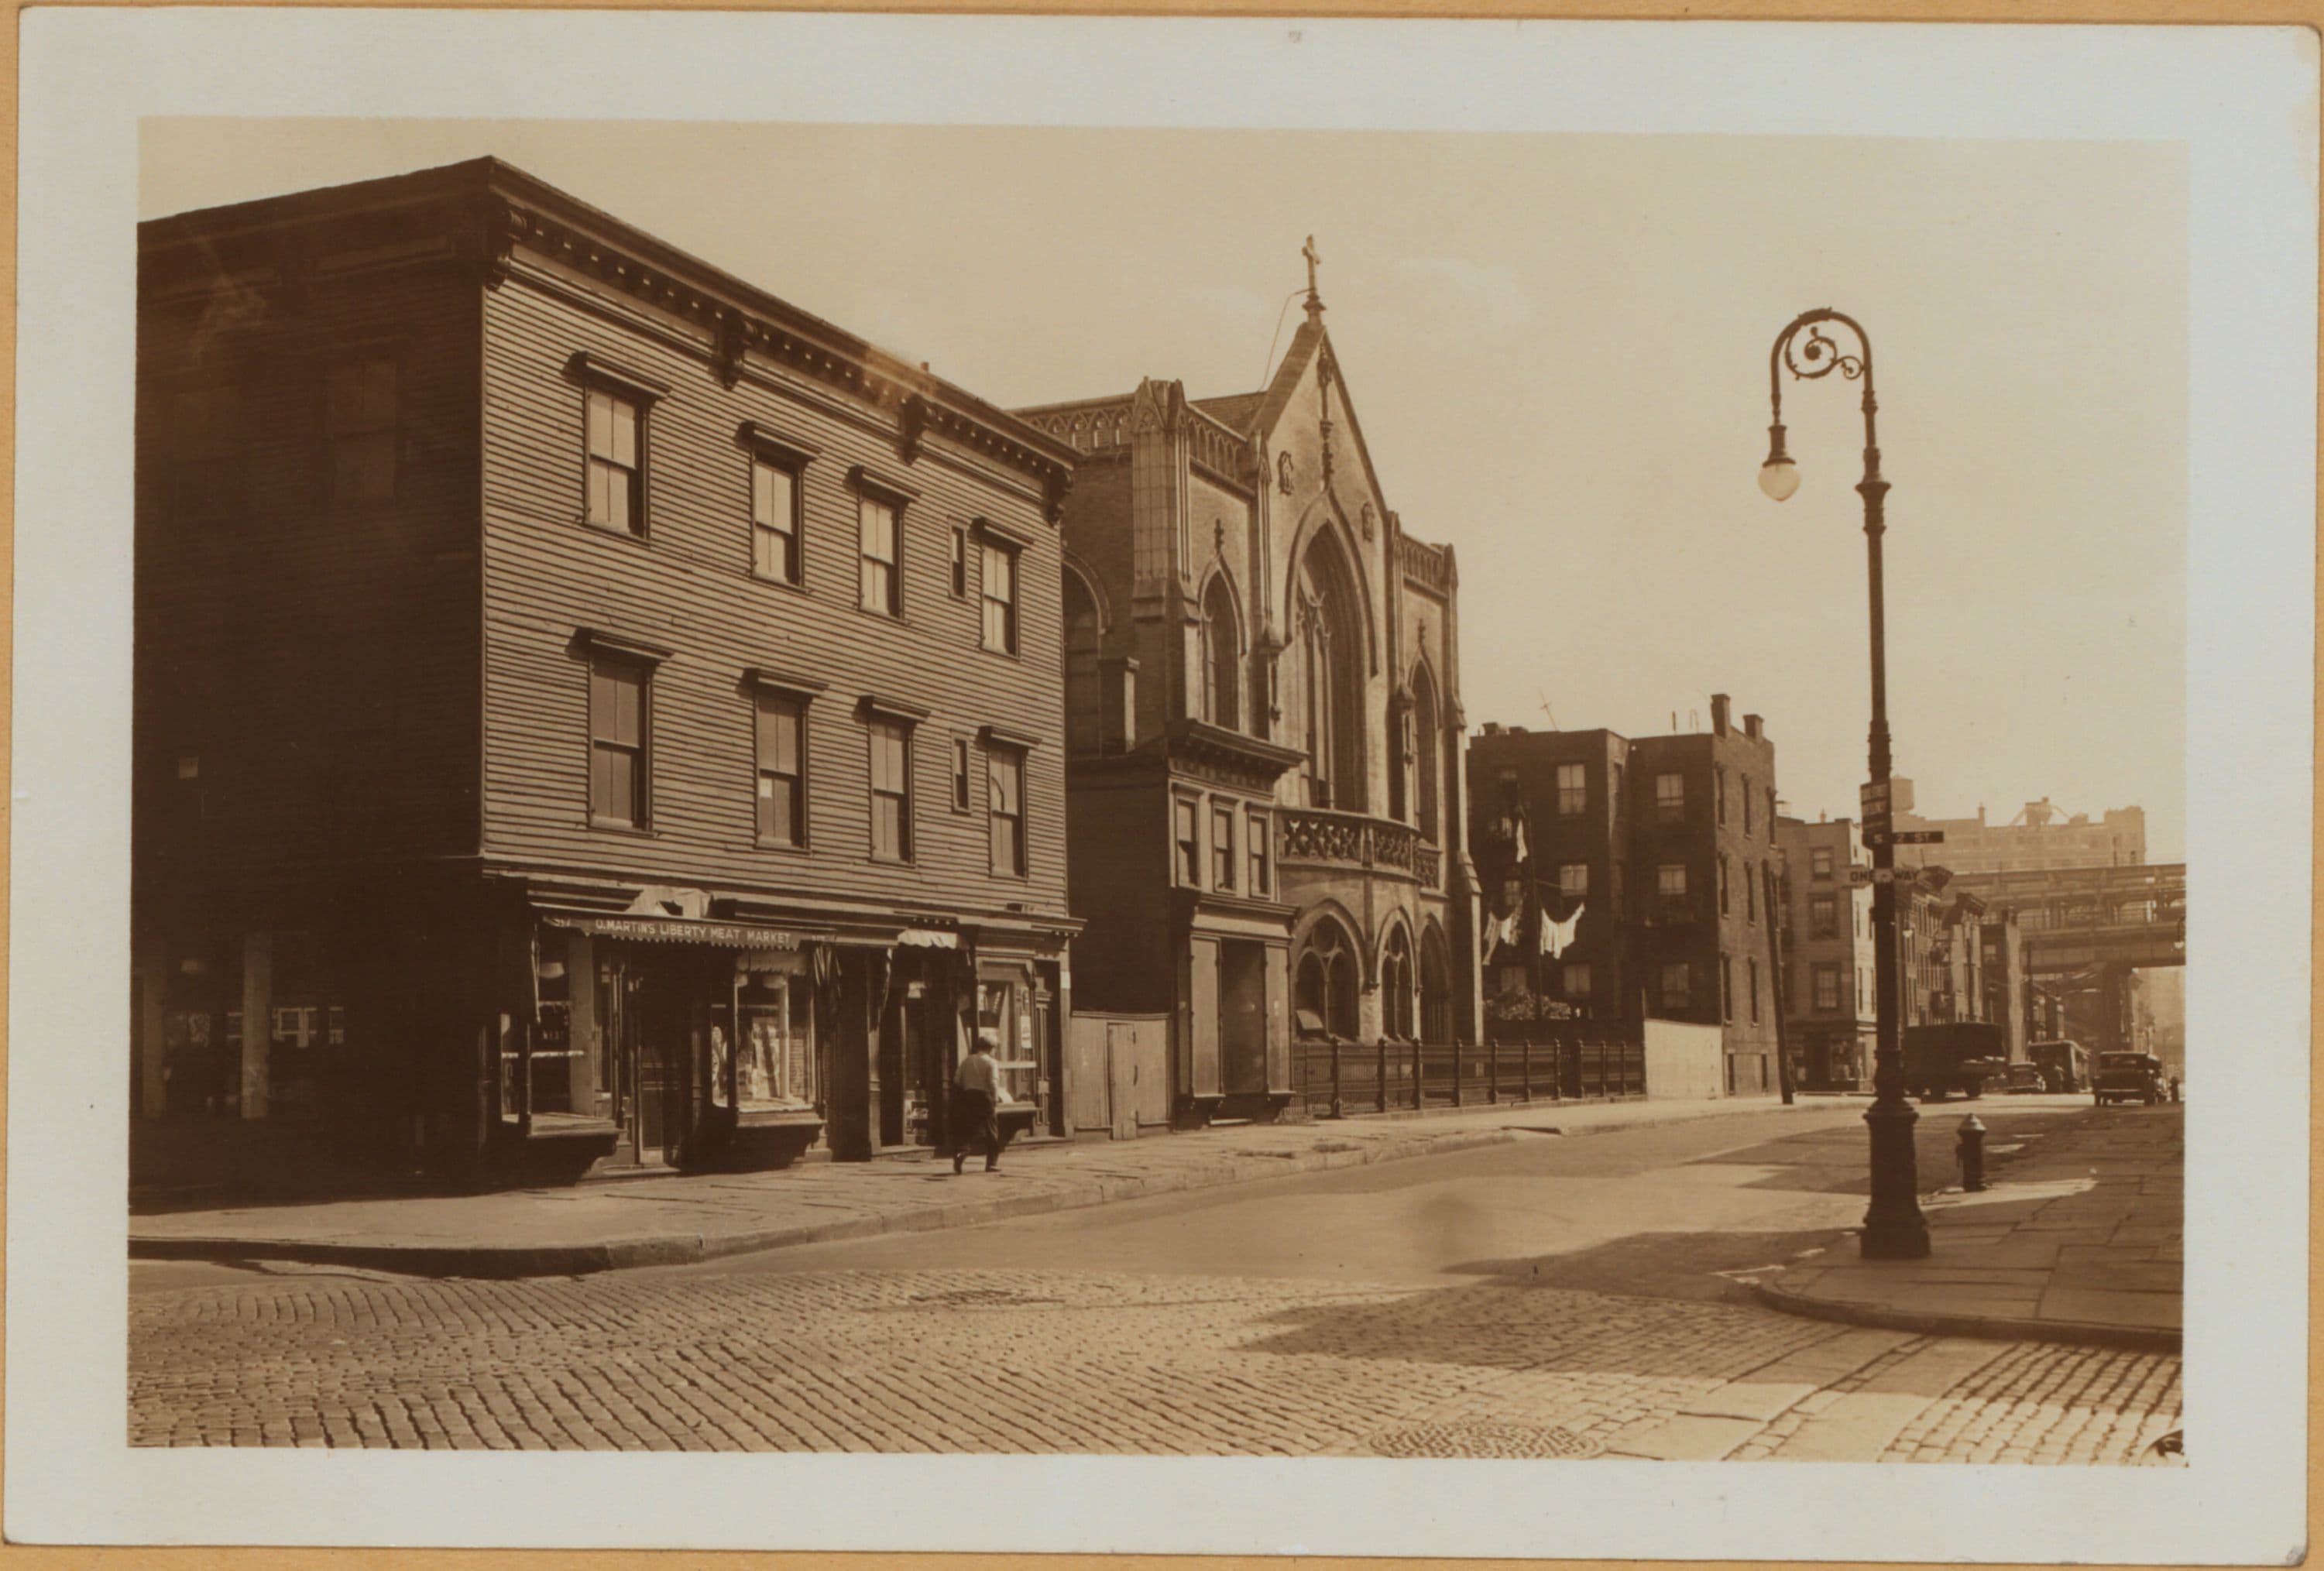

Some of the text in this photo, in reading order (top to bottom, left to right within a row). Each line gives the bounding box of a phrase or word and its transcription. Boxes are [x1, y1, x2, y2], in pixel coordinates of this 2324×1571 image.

[1914, 832, 1931, 843] ST
[1850, 869, 1920, 882] ONE WAY
[660, 922, 707, 938] LIBERTY
[710, 928, 740, 940] MEAT
[747, 930, 791, 944] MARKET
